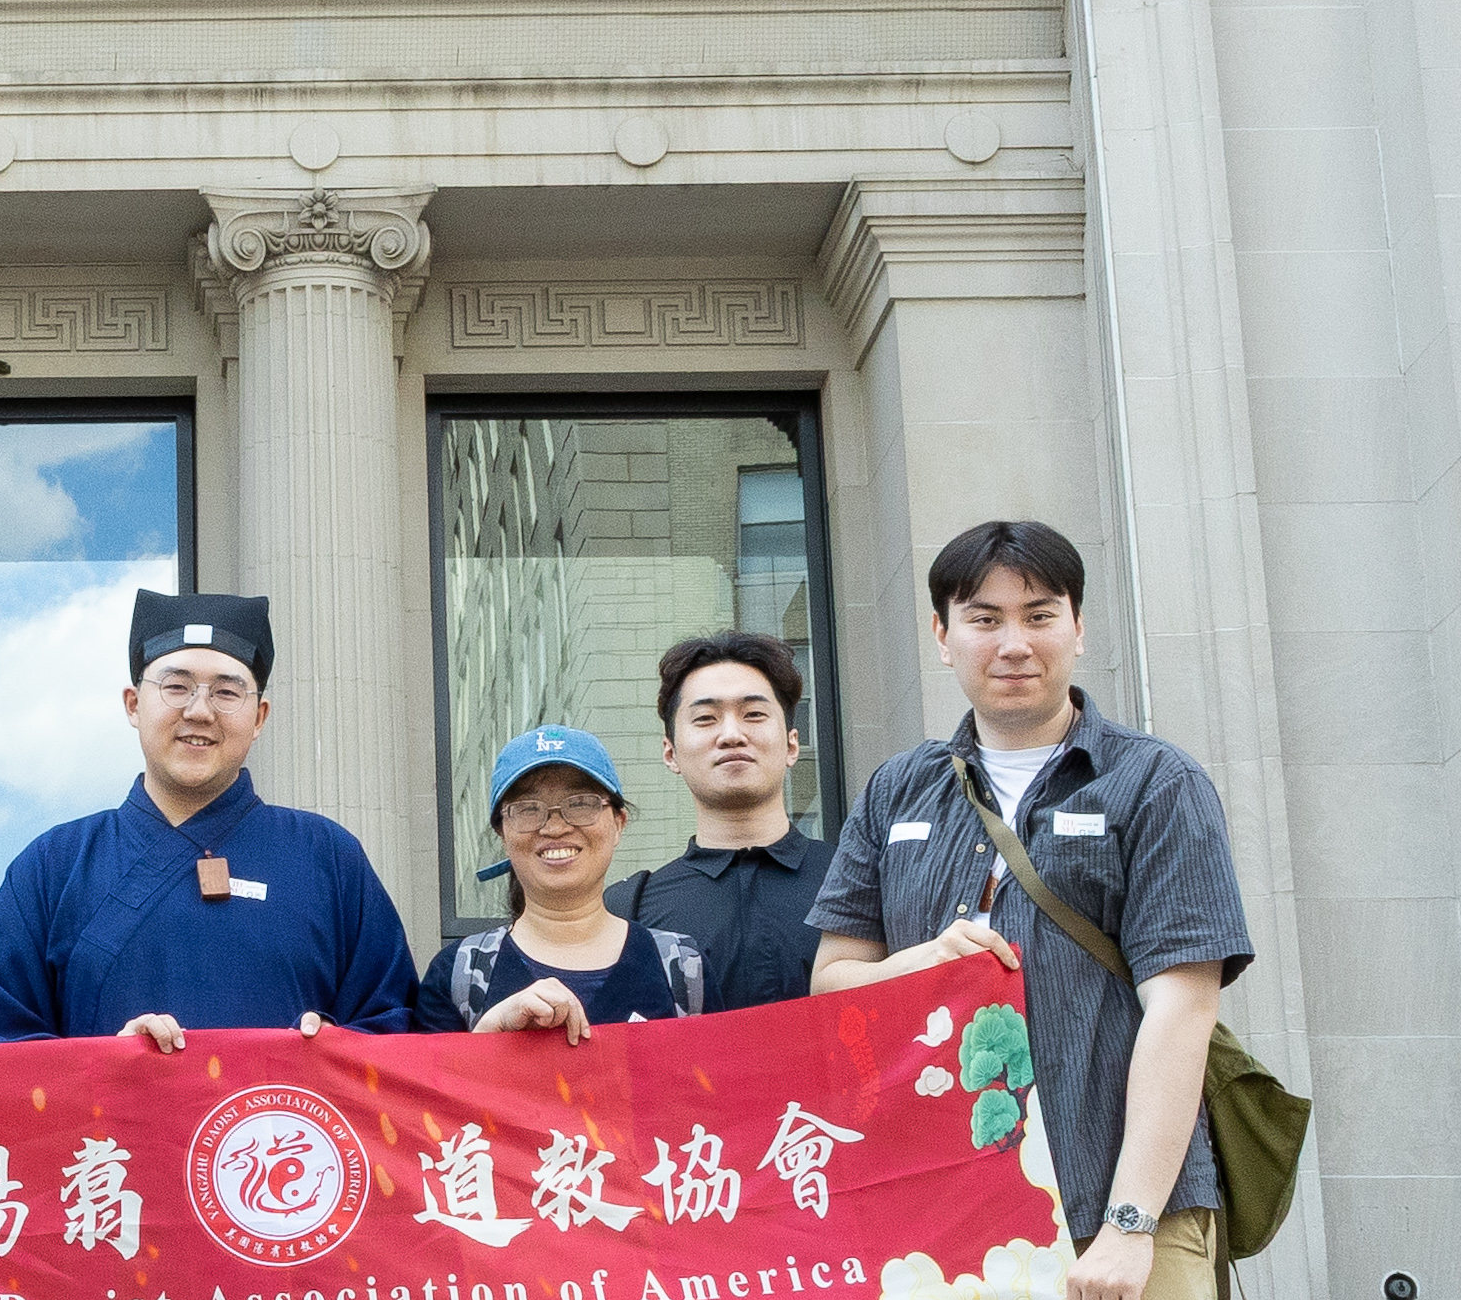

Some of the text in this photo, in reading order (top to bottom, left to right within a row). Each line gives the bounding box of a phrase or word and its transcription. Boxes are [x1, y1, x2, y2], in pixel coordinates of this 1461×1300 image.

[536, 740, 565, 752] NY
[537, 732, 545, 742] I
[196, 1093, 362, 1221] YANGZHU DAOIST ASSOCIATION OF AMERICA
[412, 1101, 866, 1248] 道教協會
